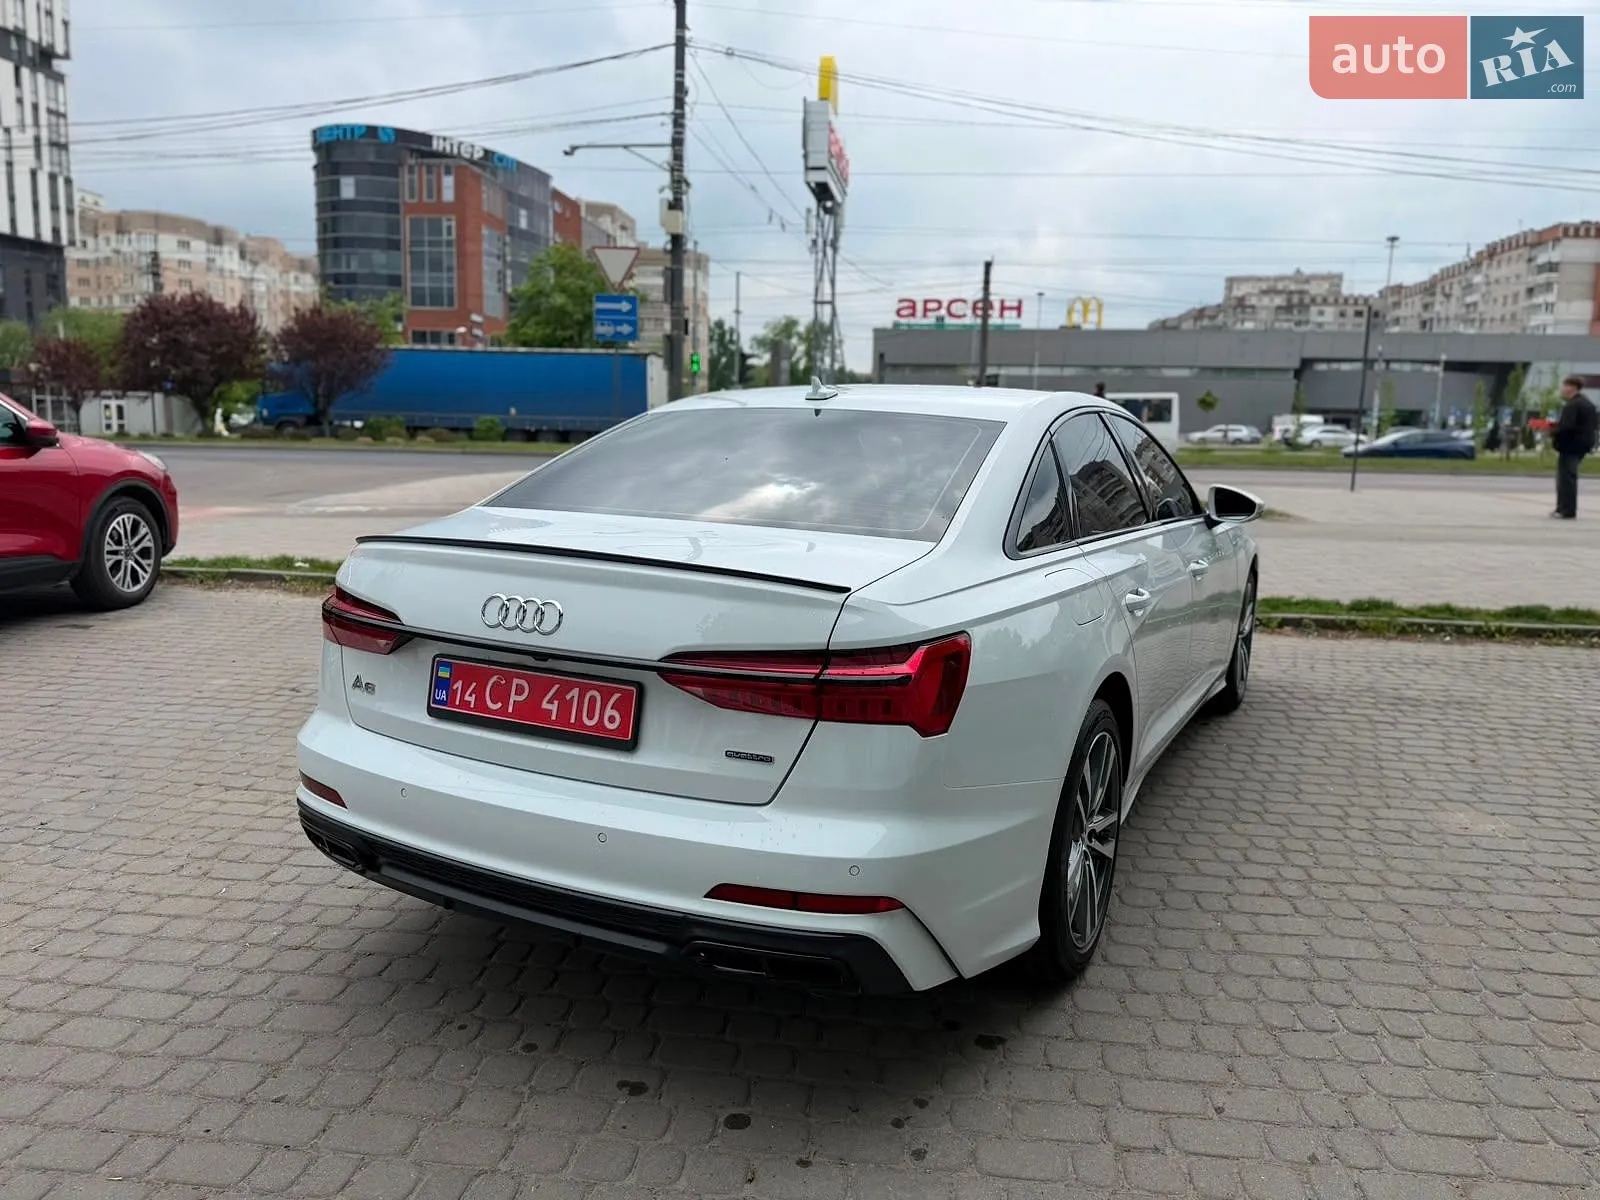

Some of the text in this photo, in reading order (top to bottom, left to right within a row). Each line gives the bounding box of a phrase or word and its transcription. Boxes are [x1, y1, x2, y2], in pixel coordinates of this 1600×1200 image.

[351, 674, 376, 696] A6
[434, 688, 447, 700] UA
[452, 675, 622, 730] 14 CP 4106
[725, 750, 772, 762] quattro
